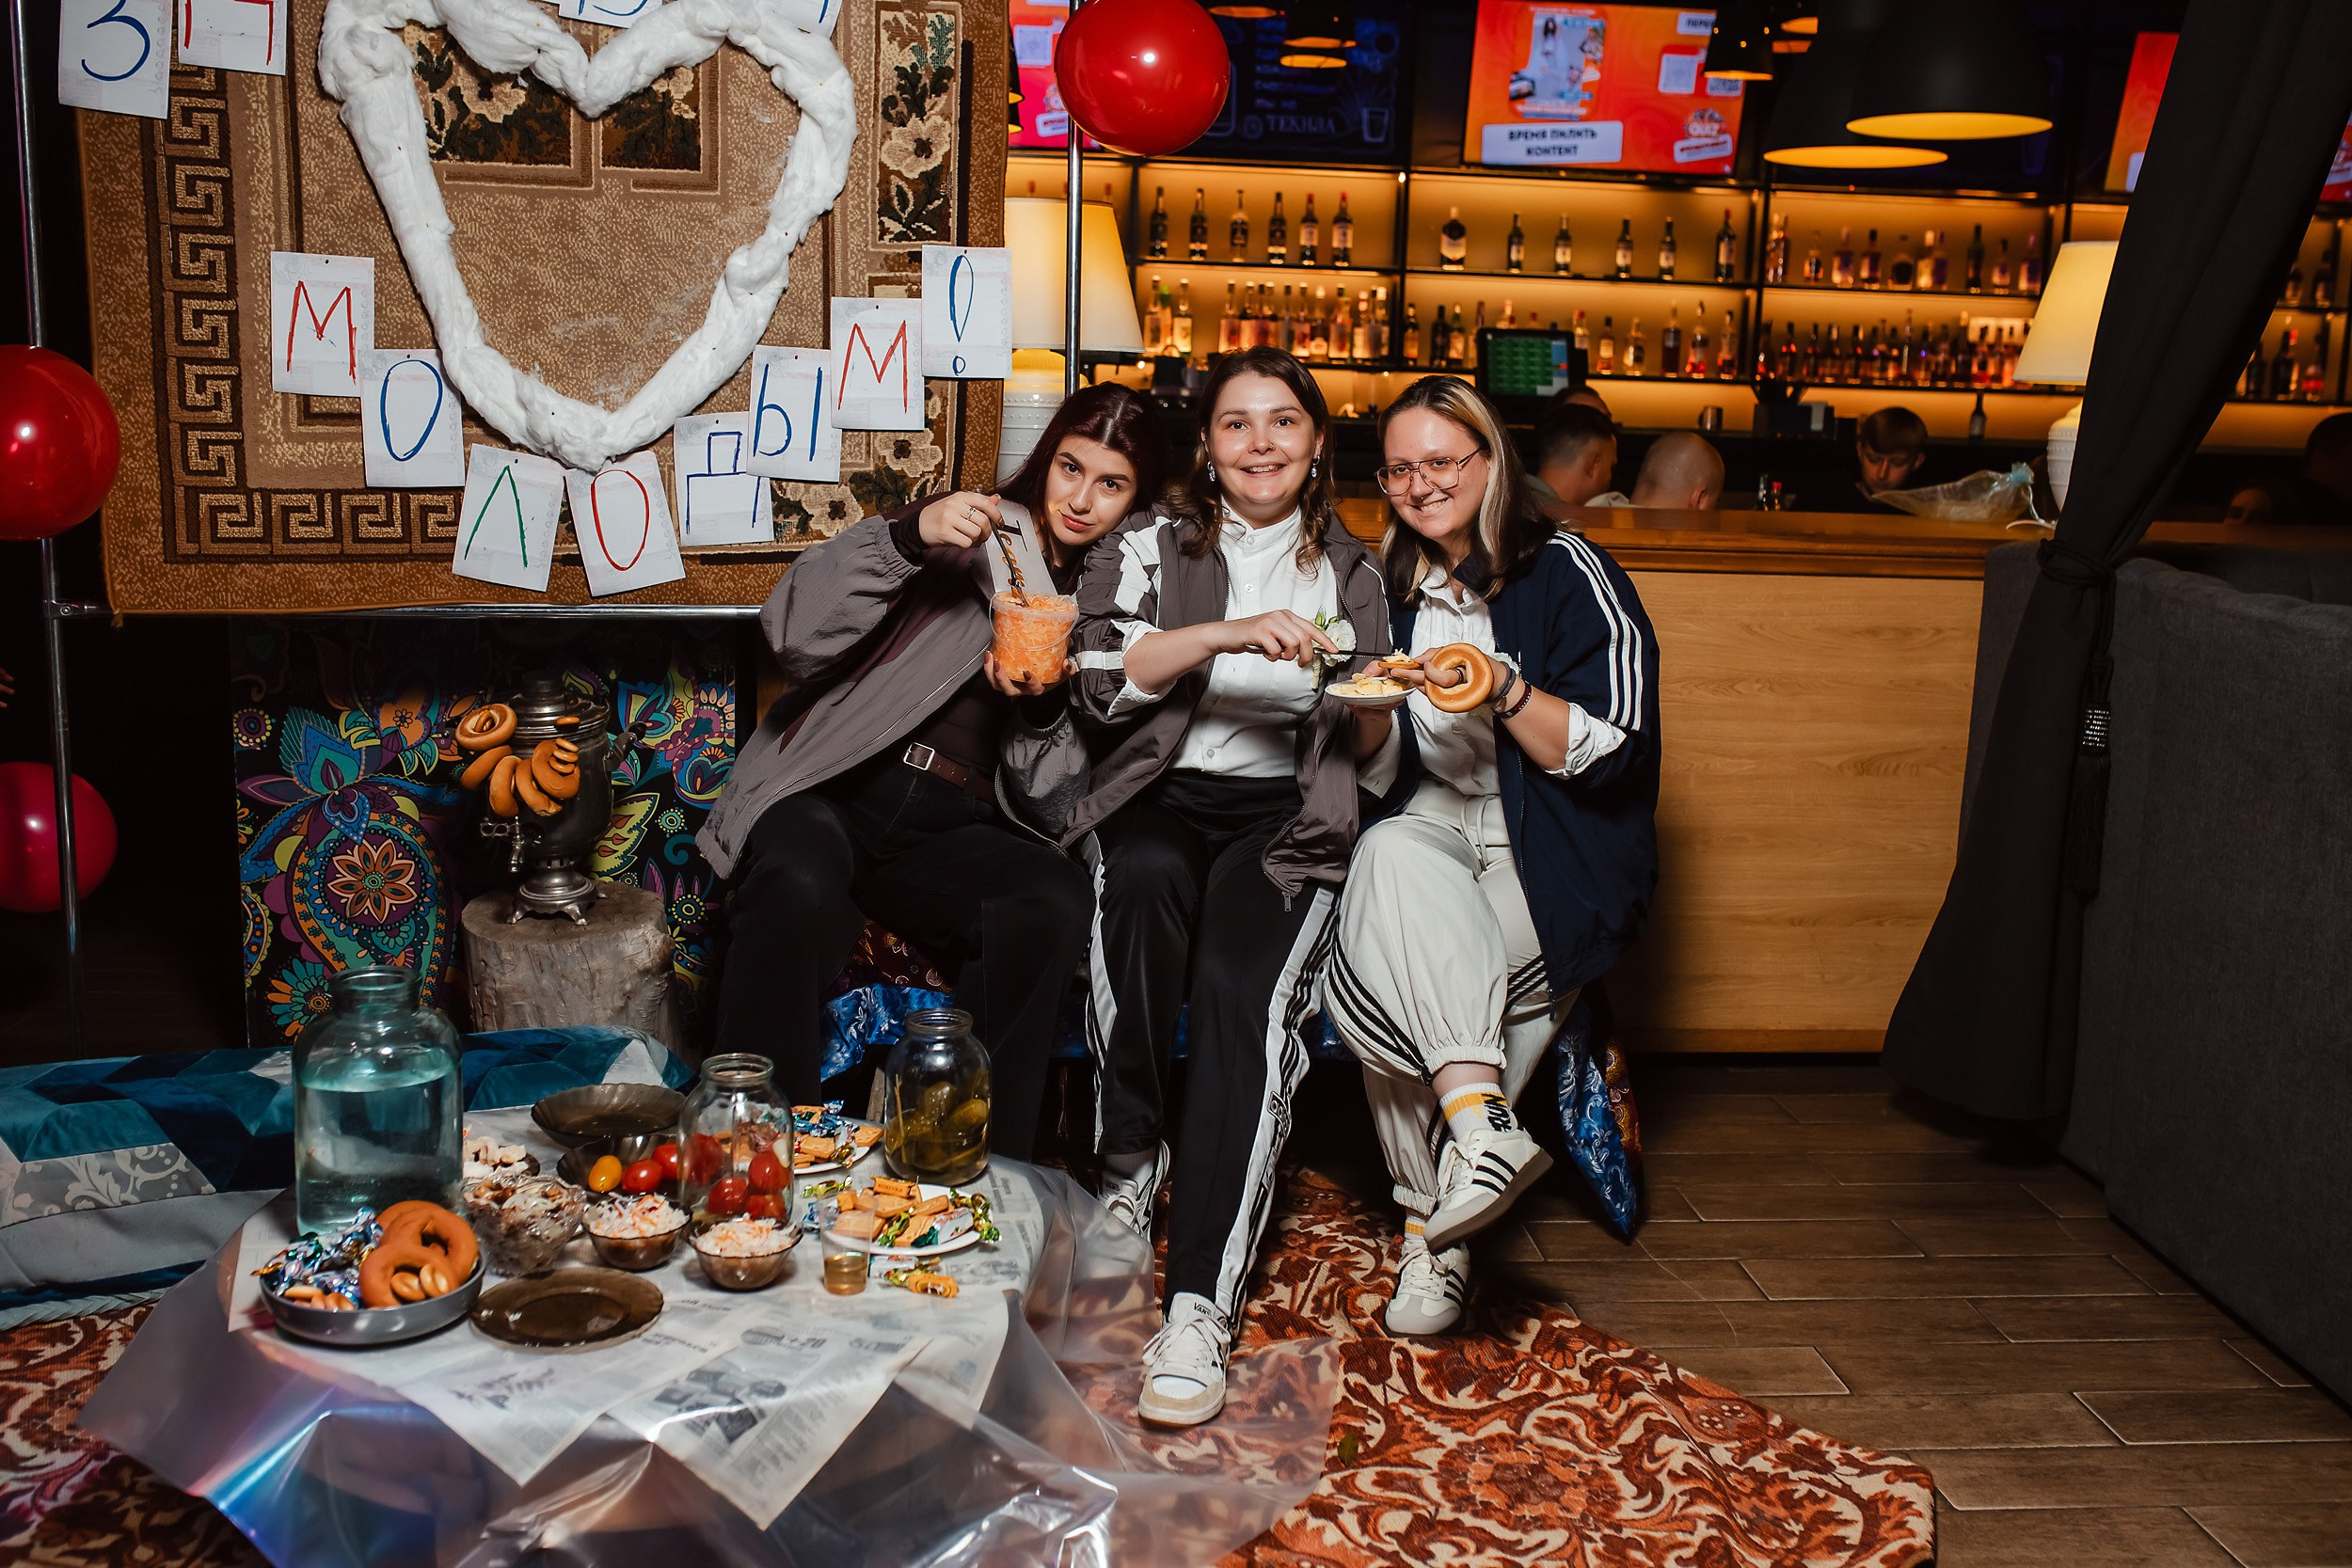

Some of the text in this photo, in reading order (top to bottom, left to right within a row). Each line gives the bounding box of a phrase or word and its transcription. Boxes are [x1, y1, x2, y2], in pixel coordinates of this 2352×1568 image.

[1508, 128, 1597, 141] ВРЕМЯ ПИЛИТЬ
[1525, 145, 1579, 156] КОНТЕНТ
[1194, 1302, 1213, 1317] VANS
